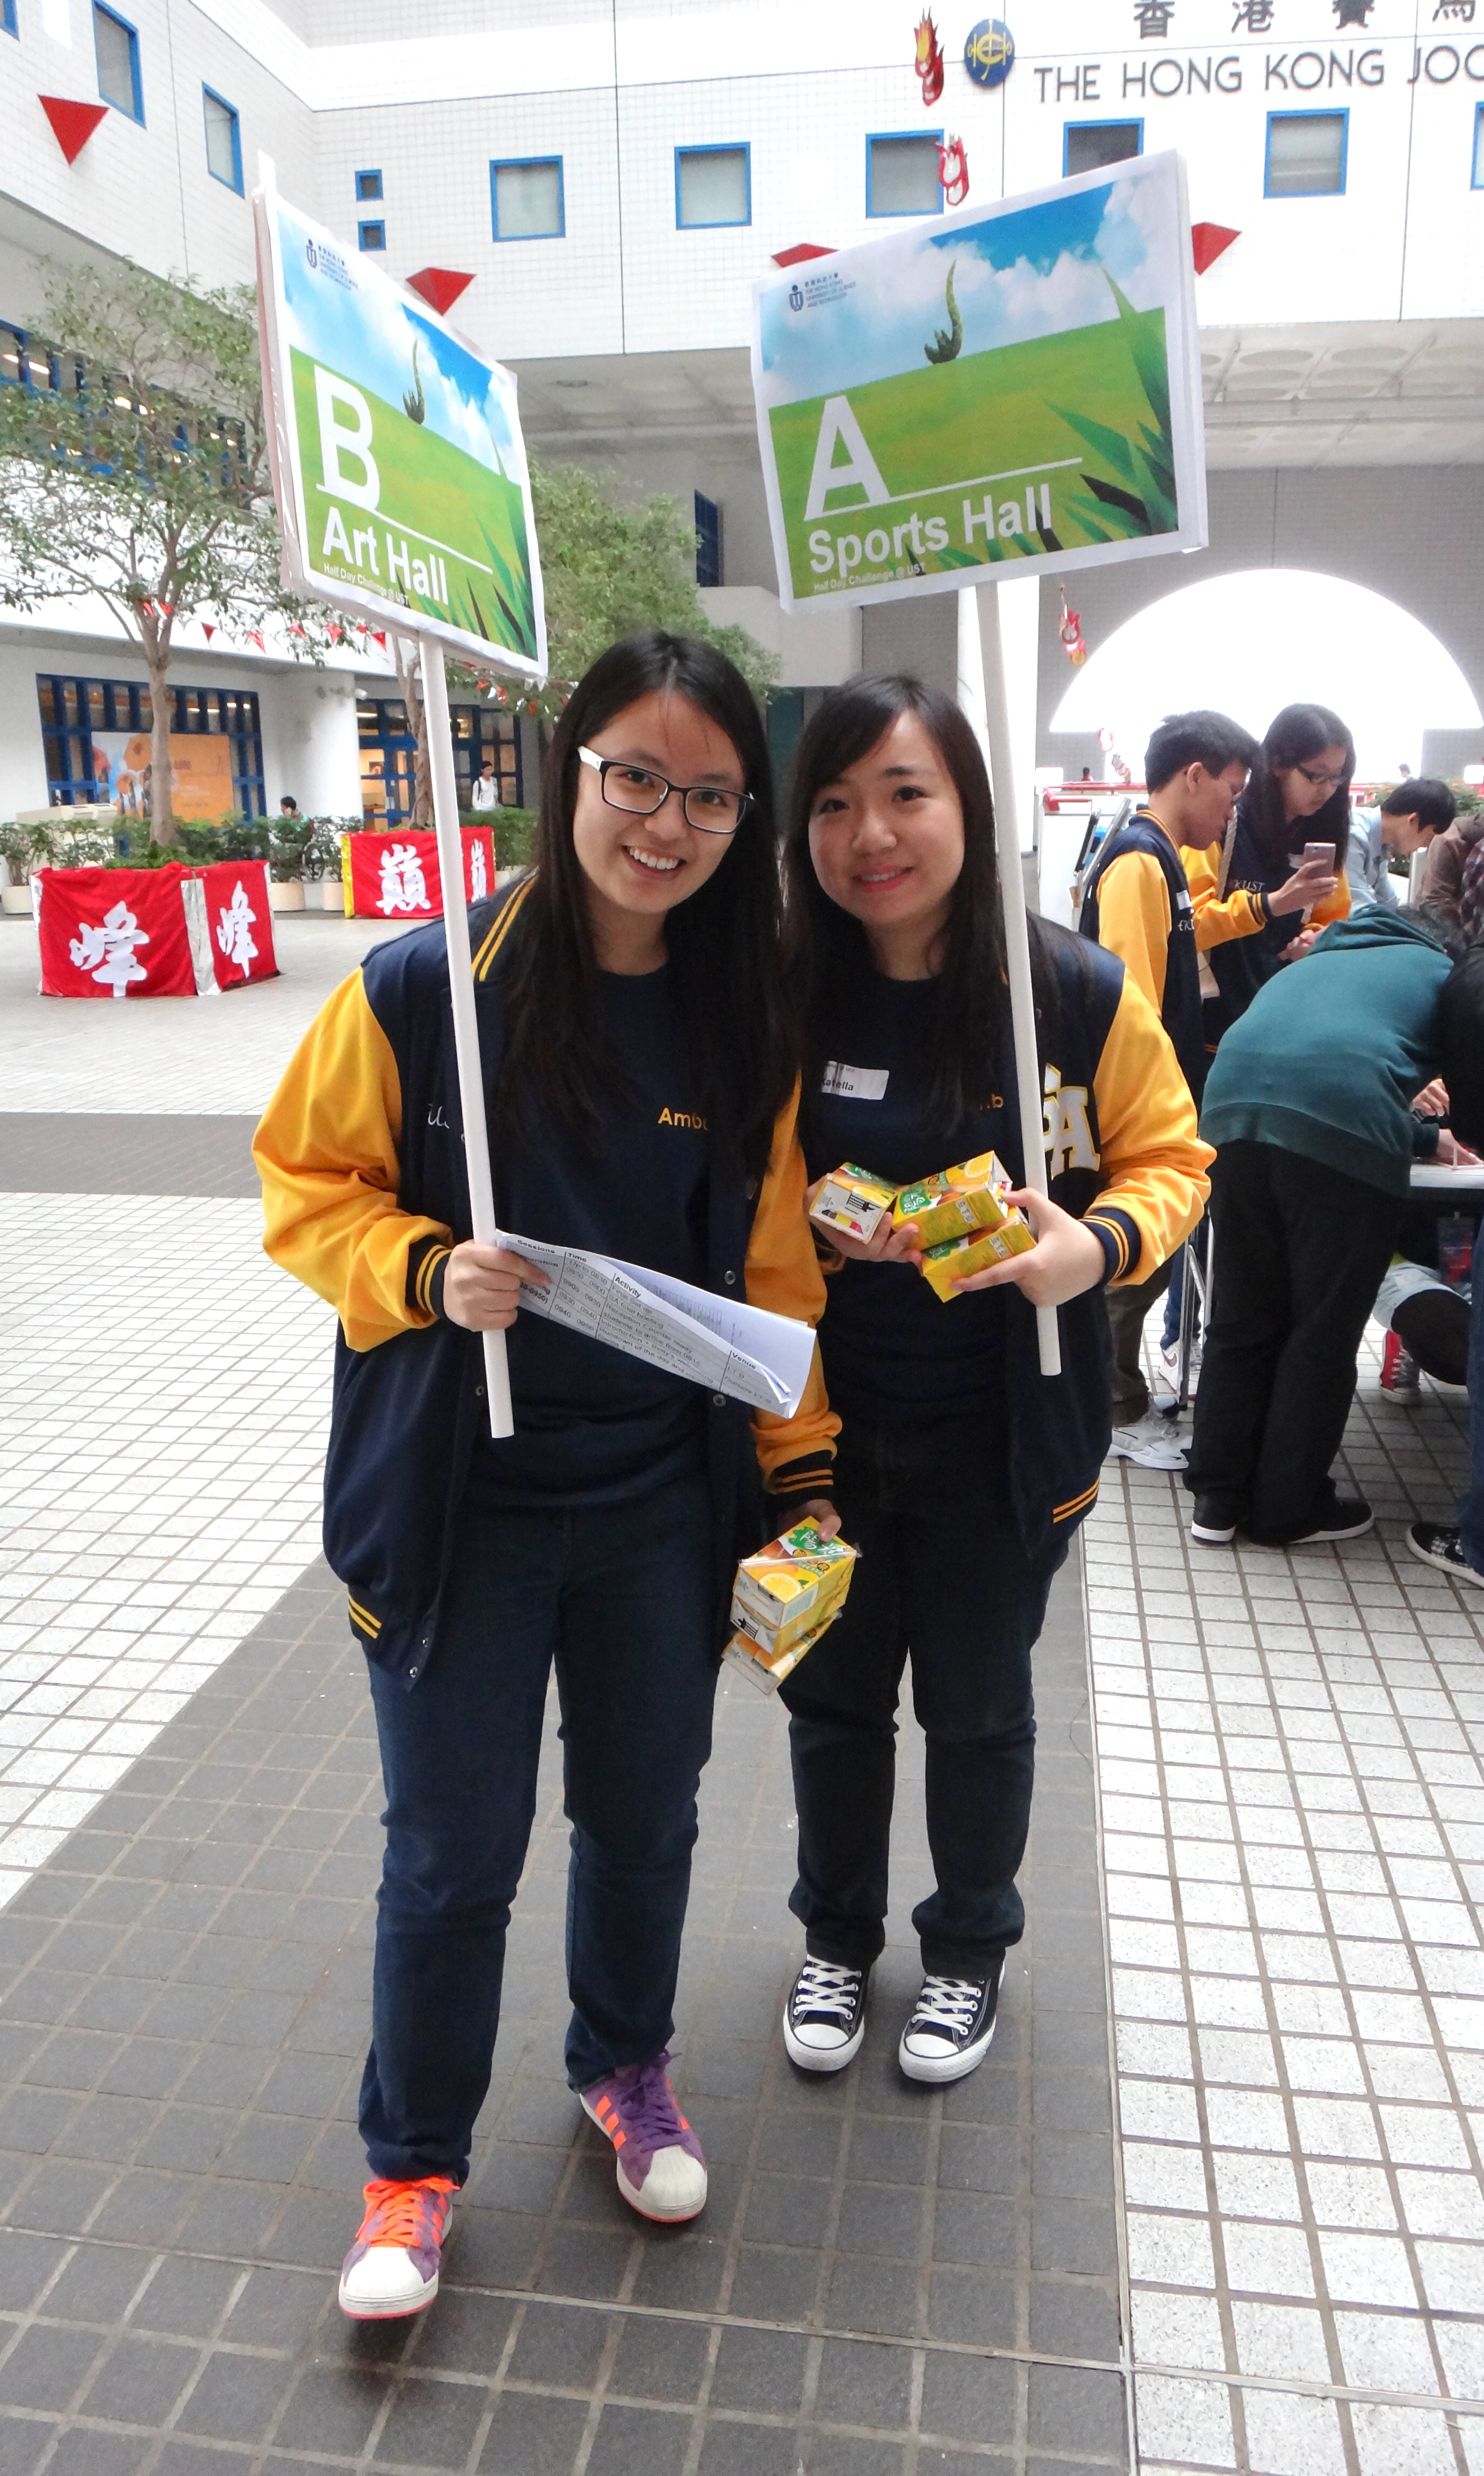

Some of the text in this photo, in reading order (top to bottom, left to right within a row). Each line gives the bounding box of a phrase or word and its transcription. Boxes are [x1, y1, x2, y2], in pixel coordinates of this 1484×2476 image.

[1034, 64, 1101, 103] THE
[1121, 55, 1243, 99] HONG
[1264, 49, 1385, 90] KONG
[313, 363, 380, 511] B
[803, 394, 891, 520] A
[808, 484, 1052, 579] Sports Hall
[322, 506, 449, 606] Art Hall
[340, 567, 356, 584] Day
[906, 562, 926, 575] UST
[517, 1239, 555, 1255] Sessions
[568, 1252, 587, 1263] Time
[615, 1276, 642, 1298] Activity
[732, 1352, 756, 1370] Venue
